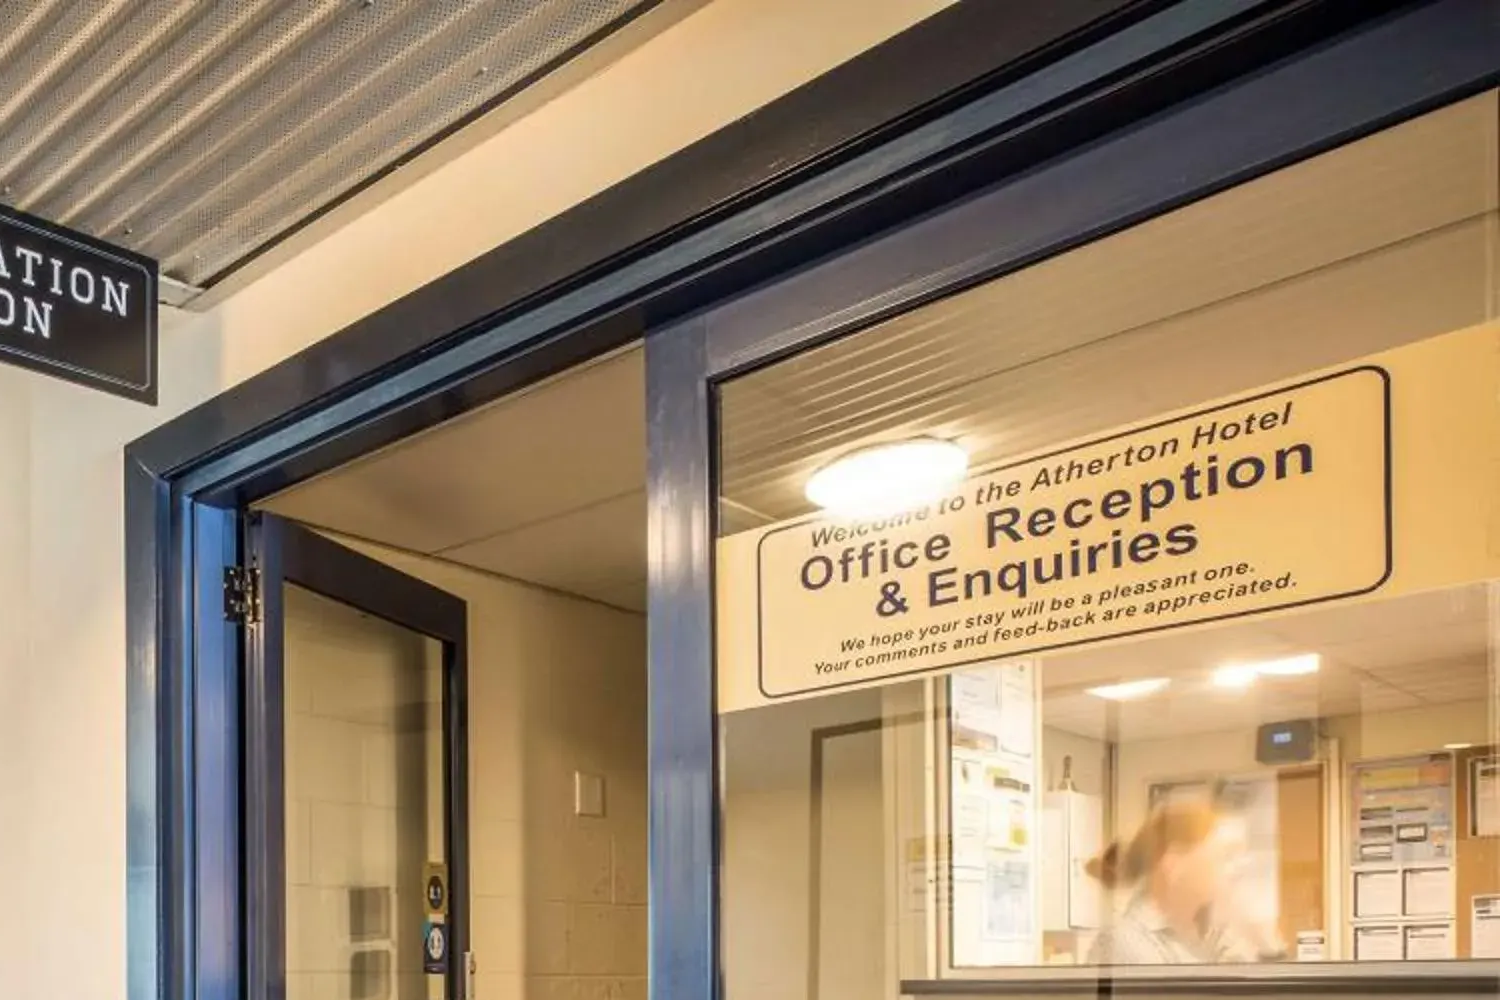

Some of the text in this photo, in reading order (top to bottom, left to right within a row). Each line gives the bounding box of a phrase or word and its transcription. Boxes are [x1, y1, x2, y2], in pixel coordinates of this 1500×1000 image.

[938, 494, 966, 516] to
[975, 479, 1021, 505] the
[1030, 436, 1180, 491] Atherton
[1191, 401, 1293, 449] Hotel
[800, 442, 1313, 590] Office Reception
[840, 561, 1256, 652] We hope your stay will be a pleasant one.
[876, 523, 1198, 617] & Enquiries
[814, 572, 1297, 675] Your comments and feed-back are appreciated.
